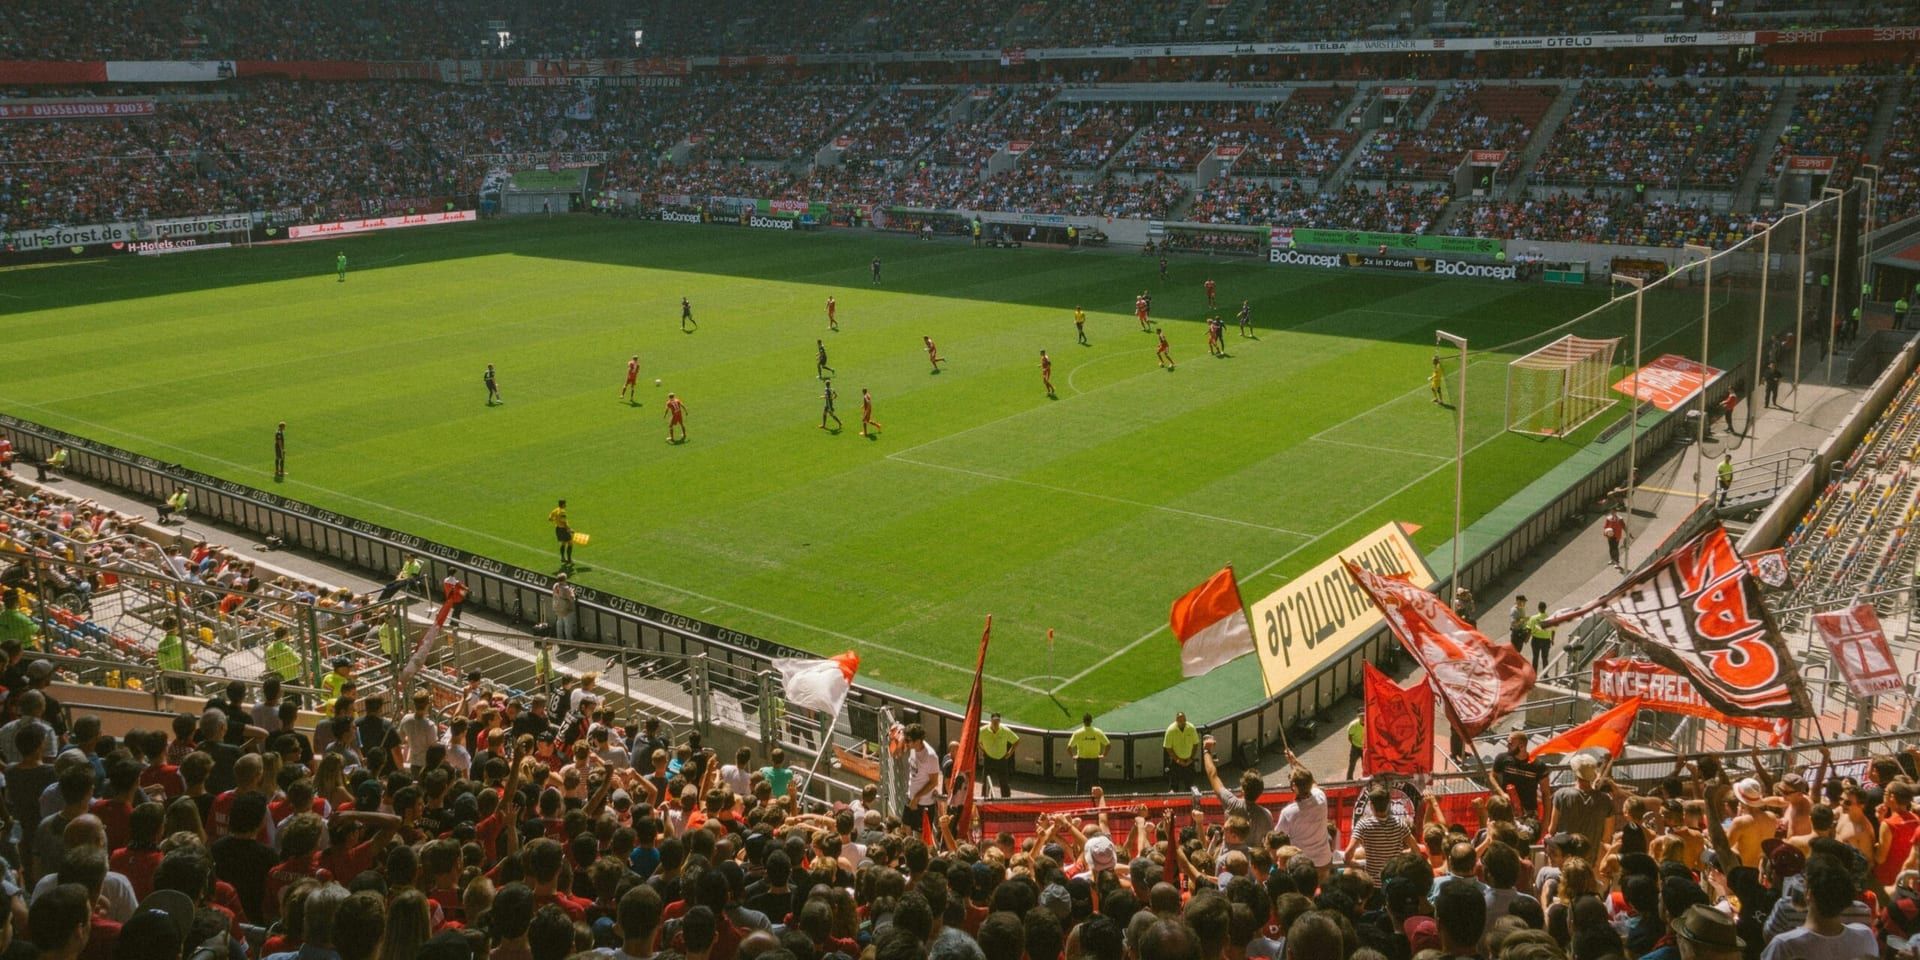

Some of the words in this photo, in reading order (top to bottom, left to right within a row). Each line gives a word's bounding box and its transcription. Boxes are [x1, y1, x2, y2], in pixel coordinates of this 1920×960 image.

[1776, 30, 1825, 43] ESPRIT
[1364, 40, 1416, 49] WARSTEINER
[507, 78, 545, 87] DIVISION
[33, 103, 109, 115] DÜSSELDORF
[114, 102, 144, 114] 2003
[1477, 152, 1501, 161] ESPRIT
[1797, 159, 1826, 168] ESPRIT
[662, 210, 700, 223] BoConcept
[750, 216, 793, 230] BoConcept
[127, 237, 196, 253] H-Hotels.com
[1270, 250, 1341, 268] BoConcept
[1375, 258, 1384, 266] in
[1435, 259, 1517, 280] BoConcept
